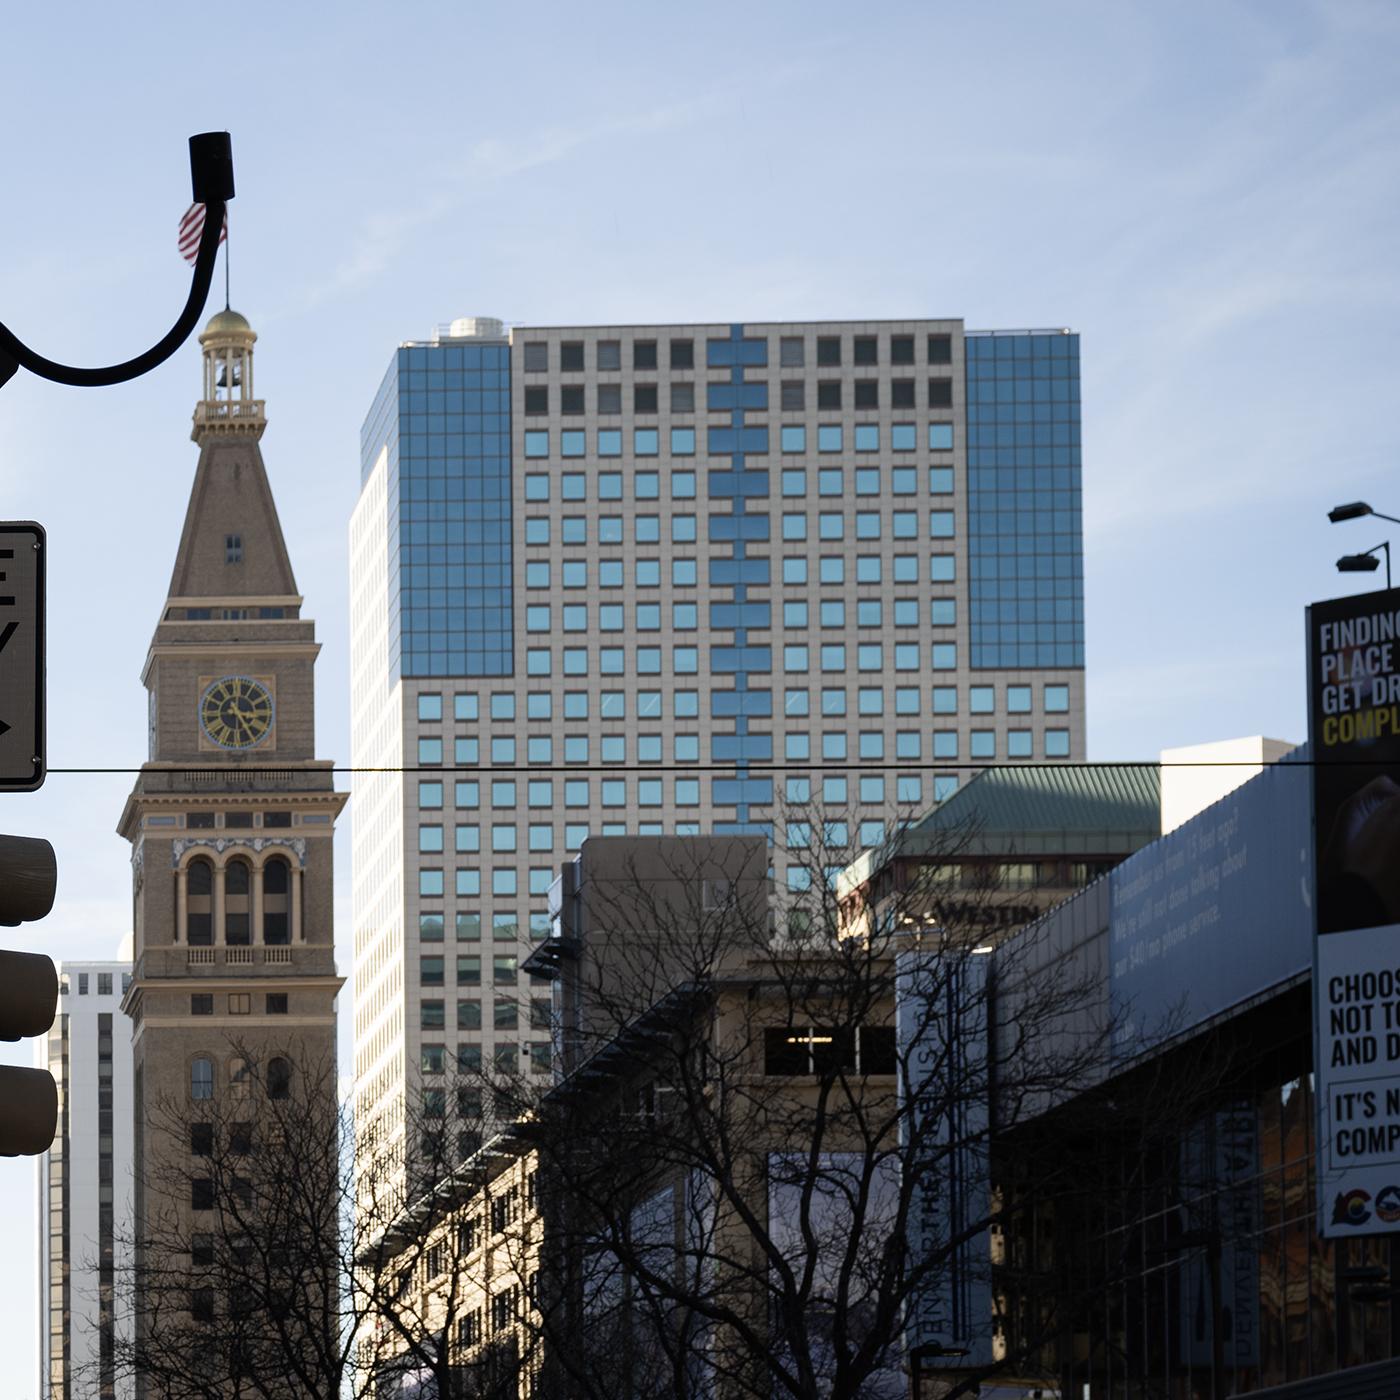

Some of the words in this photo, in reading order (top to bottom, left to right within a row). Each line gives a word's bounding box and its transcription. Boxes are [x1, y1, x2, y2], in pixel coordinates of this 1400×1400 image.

[1320, 610, 1400, 653] FINDIN
[1321, 643, 1394, 684] PLACE
[1322, 680, 1364, 715] GET
[1331, 1004, 1374, 1036] NOT
[1331, 1035, 1376, 1067] AND
[1336, 1091, 1376, 1122] IT'S
